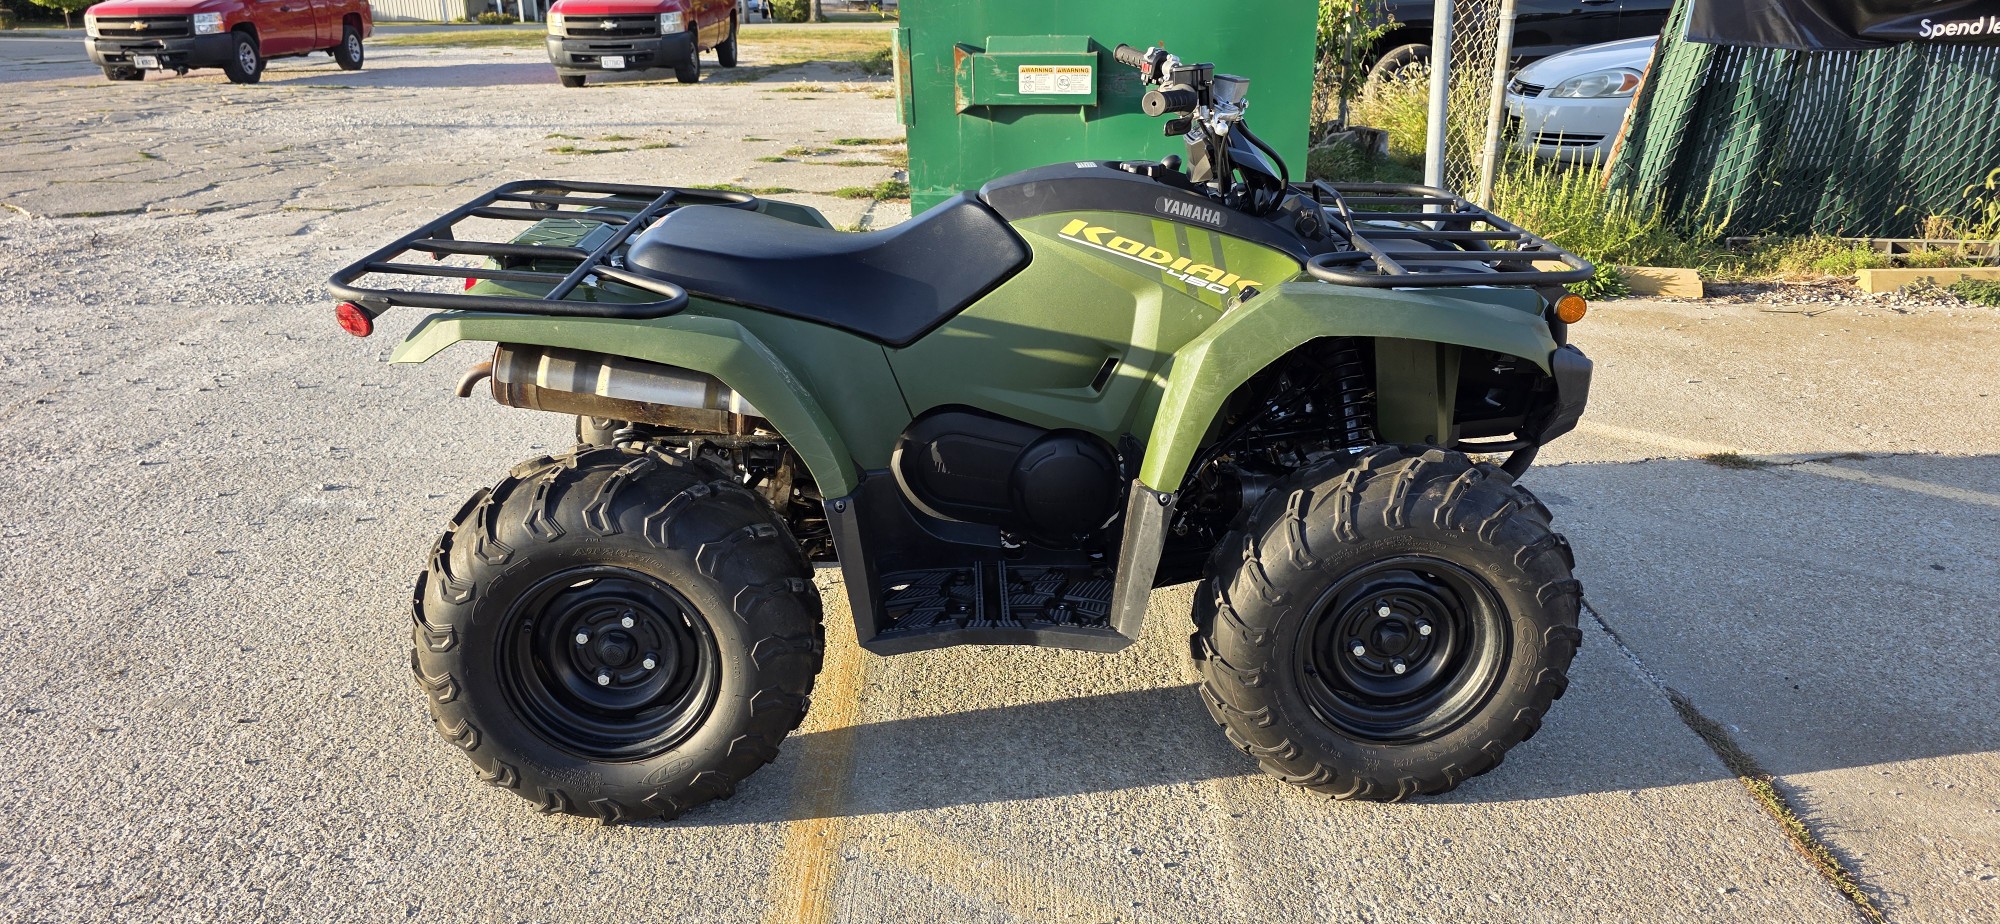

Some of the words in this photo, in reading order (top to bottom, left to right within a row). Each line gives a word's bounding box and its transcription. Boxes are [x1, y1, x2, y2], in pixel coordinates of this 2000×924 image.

[1919, 16, 1984, 40] Spend
[1164, 198, 1220, 225] YAMAHA
[1166, 269, 1230, 294] 450
[1509, 616, 1539, 693] CST
